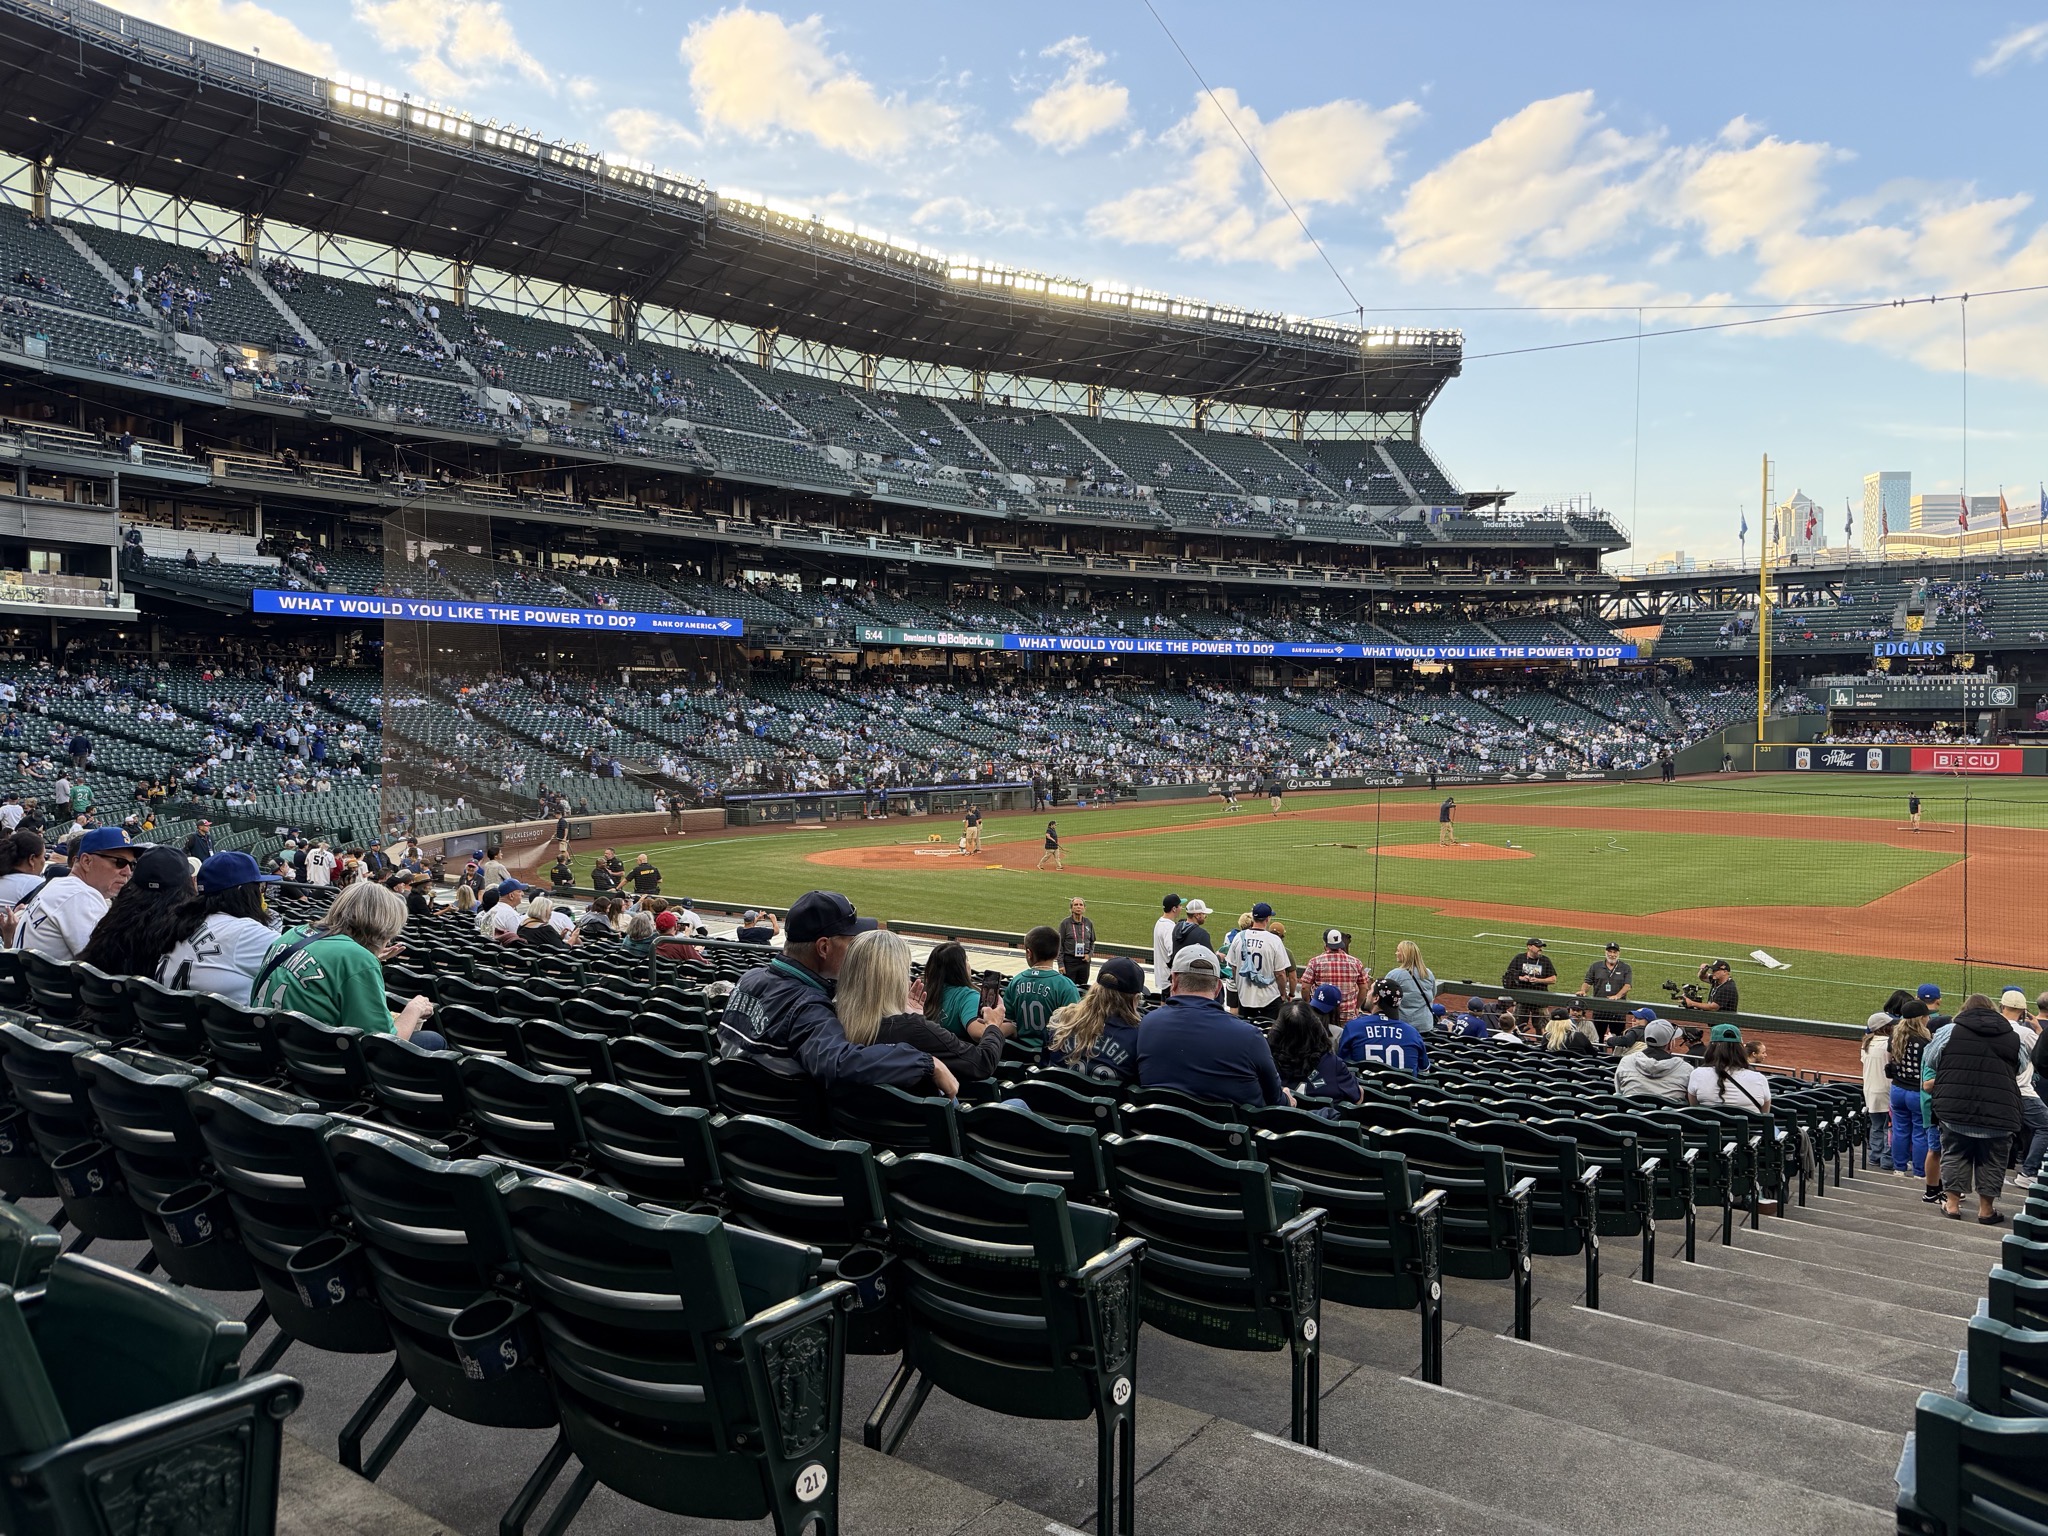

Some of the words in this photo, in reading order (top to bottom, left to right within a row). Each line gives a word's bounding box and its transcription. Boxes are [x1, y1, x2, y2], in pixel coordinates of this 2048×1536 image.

[279, 596, 334, 611] WHAT
[339, 600, 403, 615] WOULD
[408, 604, 443, 617] YOU
[448, 607, 484, 620] LIKE
[488, 608, 520, 621] THE
[524, 610, 580, 624] POWER
[584, 614, 604, 625] TO
[608, 615, 636, 627] DO?
[652, 620, 673, 628] BANK
[685, 622, 717, 630] AMERICA
[865, 630, 883, 640] 5:44
[903, 633, 927, 643] Download
[928, 634, 936, 643] the
[947, 634, 984, 646] Ballpark
[985, 638, 995, 647] App
[1019, 638, 1056, 649] WHAT
[1060, 639, 1105, 650] WOULD
[1109, 640, 1134, 651] YOU
[1137, 641, 1162, 652] LIKE
[1166, 642, 1189, 652] THE
[1192, 643, 1232, 653] POWER
[1235, 644, 1250, 653] TO
[1253, 644, 1274, 654] DO?
[1362, 647, 1392, 656] WHAT
[1395, 648, 1435, 657] WOULD
[1439, 648, 1465, 657] YOU
[1469, 648, 1496, 657] LIKE
[1500, 648, 1524, 657] THE
[1528, 648, 1573, 657] POWER
[1577, 648, 1594, 657] TO
[1597, 648, 1621, 657] DO?
[1874, 641, 1945, 657] EDGAR'S
[1798, 750, 1809, 758] Lite
[1821, 752, 1855, 766] Miller
[1869, 751, 1880, 759] Lite
[1939, 755, 1994, 766] BECU
[1386, 777, 1405, 786] Clips
[77, 793, 88, 801] 24
[505, 829, 544, 840] MUCKLESHOOT
[313, 855, 324, 866] 51
[1244, 939, 1263, 948] ETTS
[1017, 982, 1050, 997] ROBLES
[1021, 1000, 1046, 1031] 10
[1366, 1026, 1403, 1039] BETTS
[1365, 1044, 1405, 1069] 50
[1116, 1383, 1128, 1400] 20
[803, 1472, 820, 1494] 21
